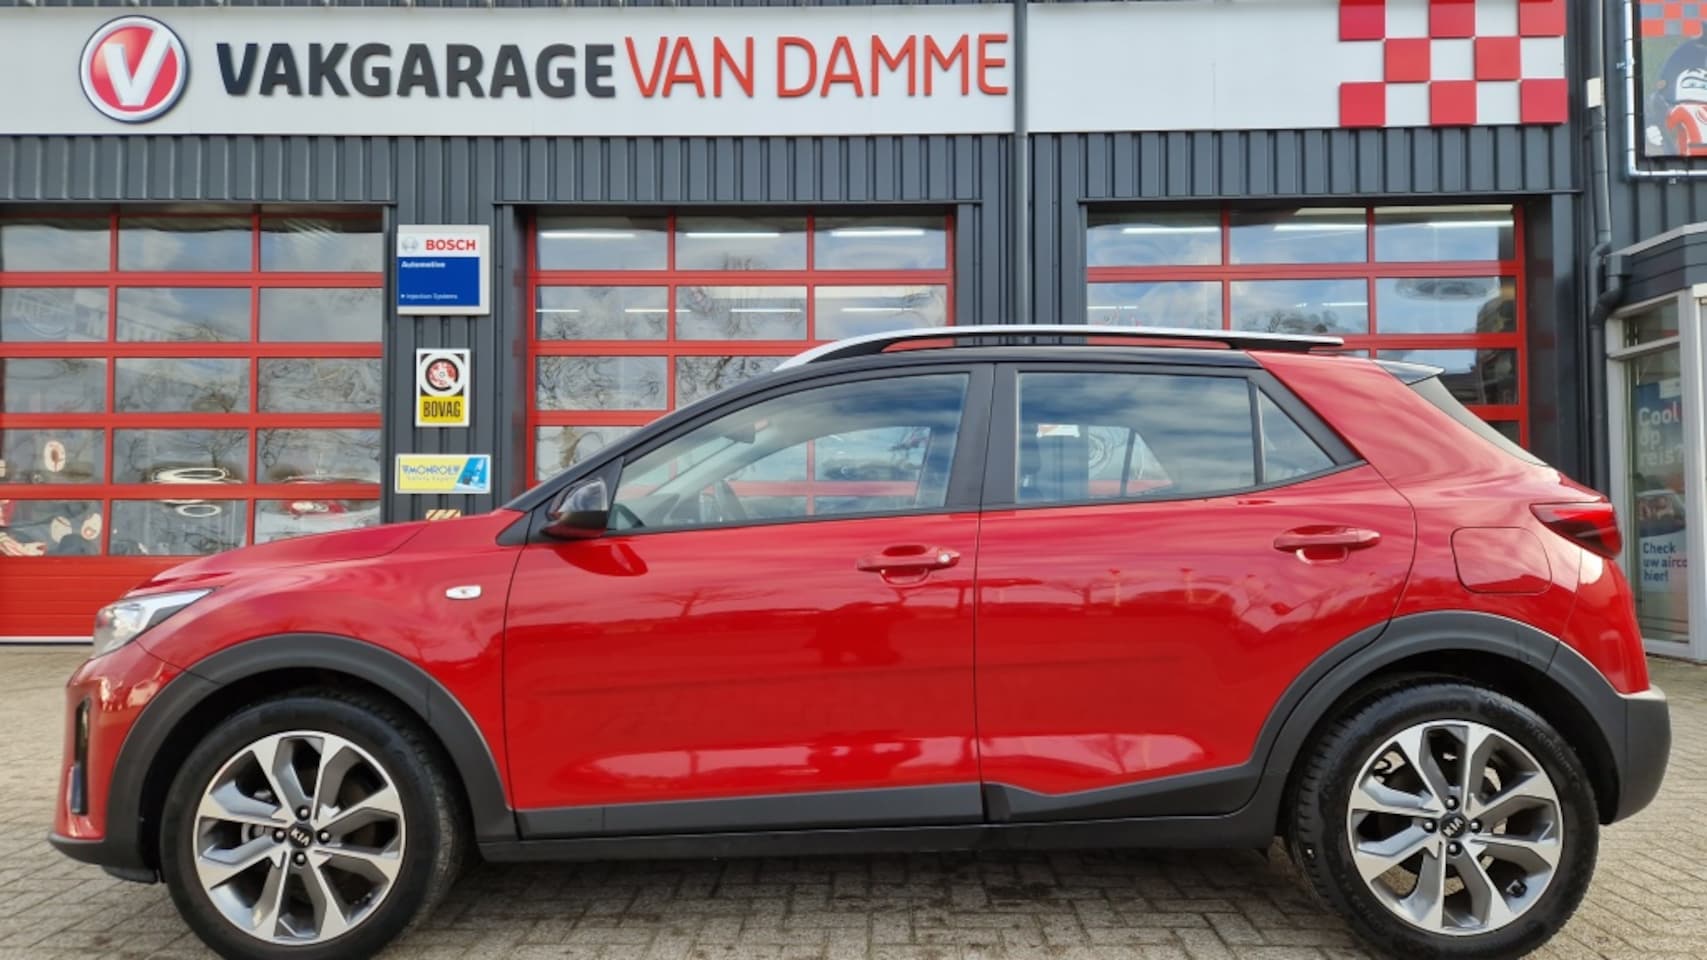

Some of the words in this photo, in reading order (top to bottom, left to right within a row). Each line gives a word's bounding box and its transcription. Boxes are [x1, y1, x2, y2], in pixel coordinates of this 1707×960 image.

[216, 42, 615, 99] VAKGARAGE
[625, 36, 754, 98] VAN
[777, 34, 1008, 98] DAMME
[425, 239, 476, 251] BOSCH
[401, 260, 446, 268] Automotive
[423, 401, 461, 417] BOVAG
[1638, 401, 1679, 425] Cool
[1643, 542, 1676, 554] Check
[1643, 559, 1660, 568] uw
[1644, 569, 1668, 582] hier!
[1443, 817, 1464, 836] KIA
[290, 827, 310, 846] KIA
